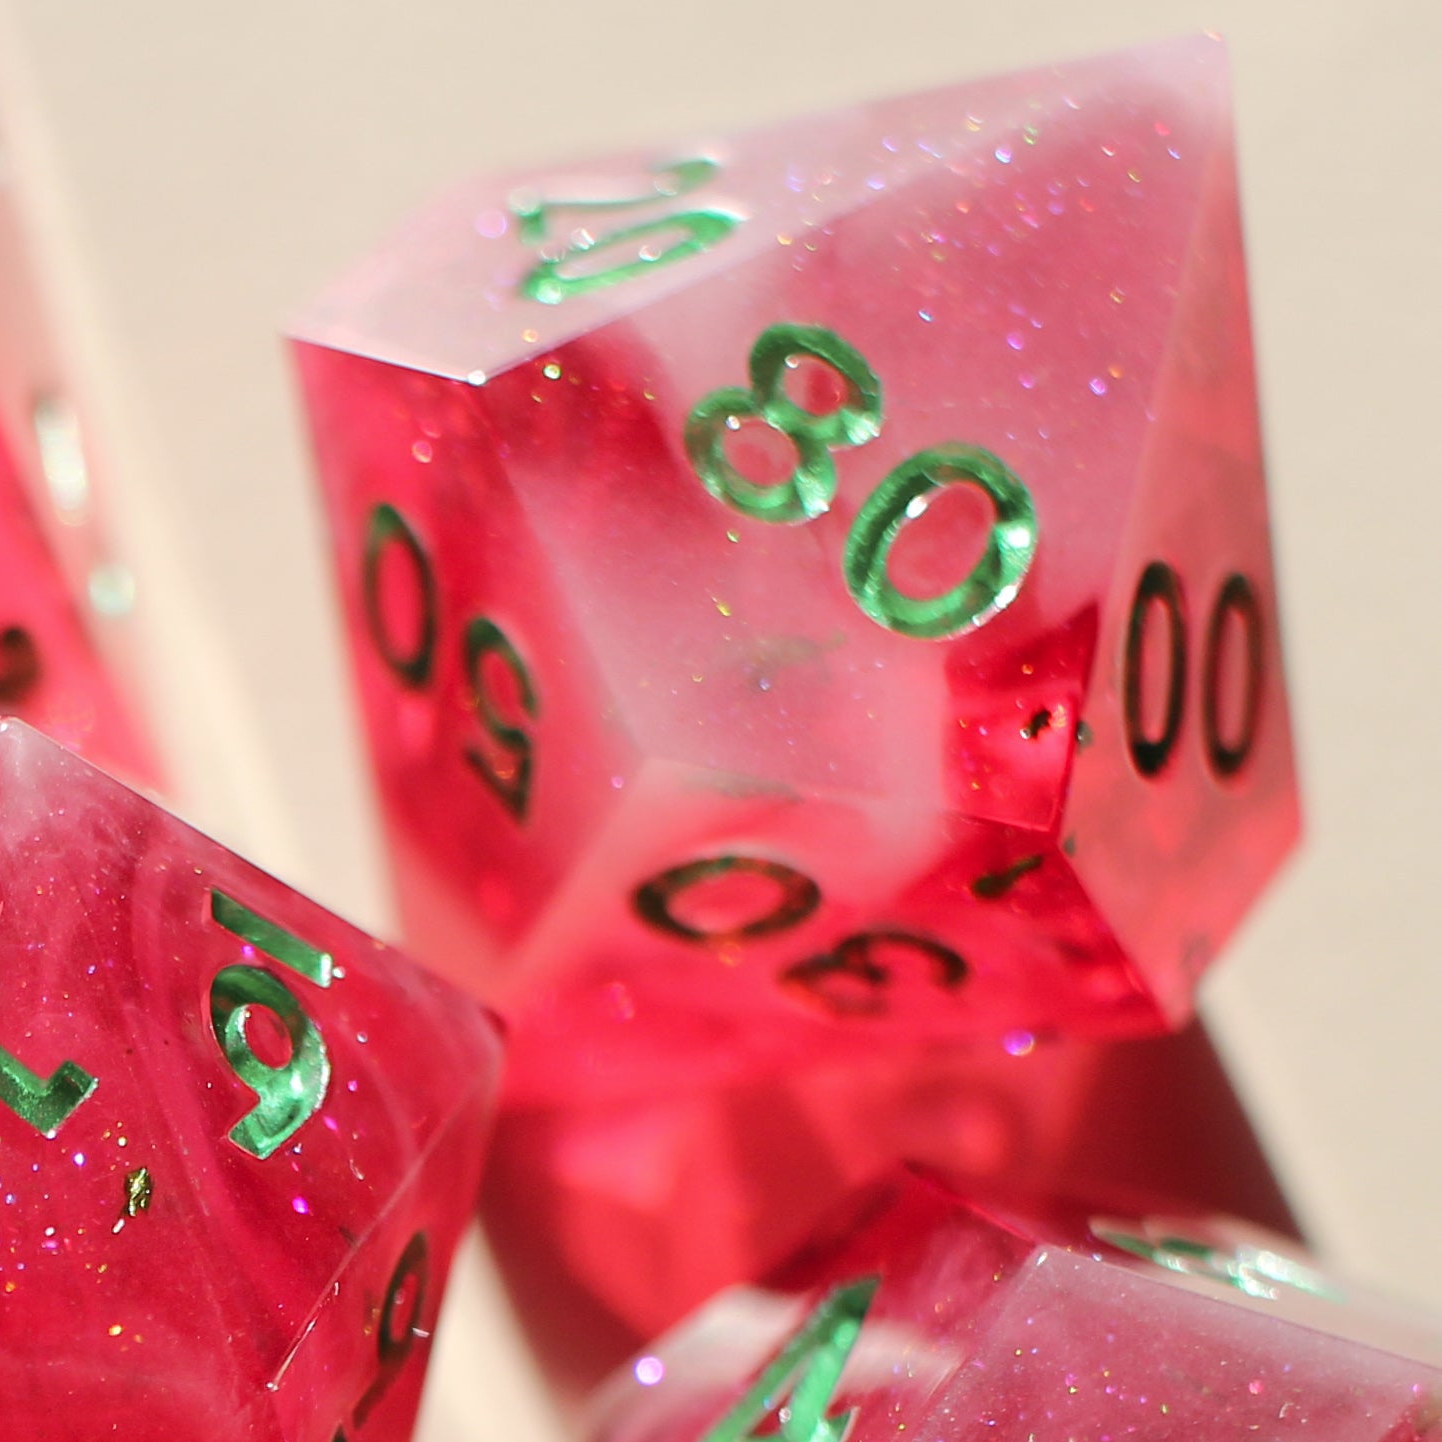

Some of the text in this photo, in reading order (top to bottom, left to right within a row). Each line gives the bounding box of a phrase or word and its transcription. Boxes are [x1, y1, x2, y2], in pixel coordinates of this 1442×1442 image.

[683, 322, 1038, 641] 80
[363, 502, 541, 830] 50
[1123, 561, 1265, 779] 00
[630, 855, 971, 1018] 30
